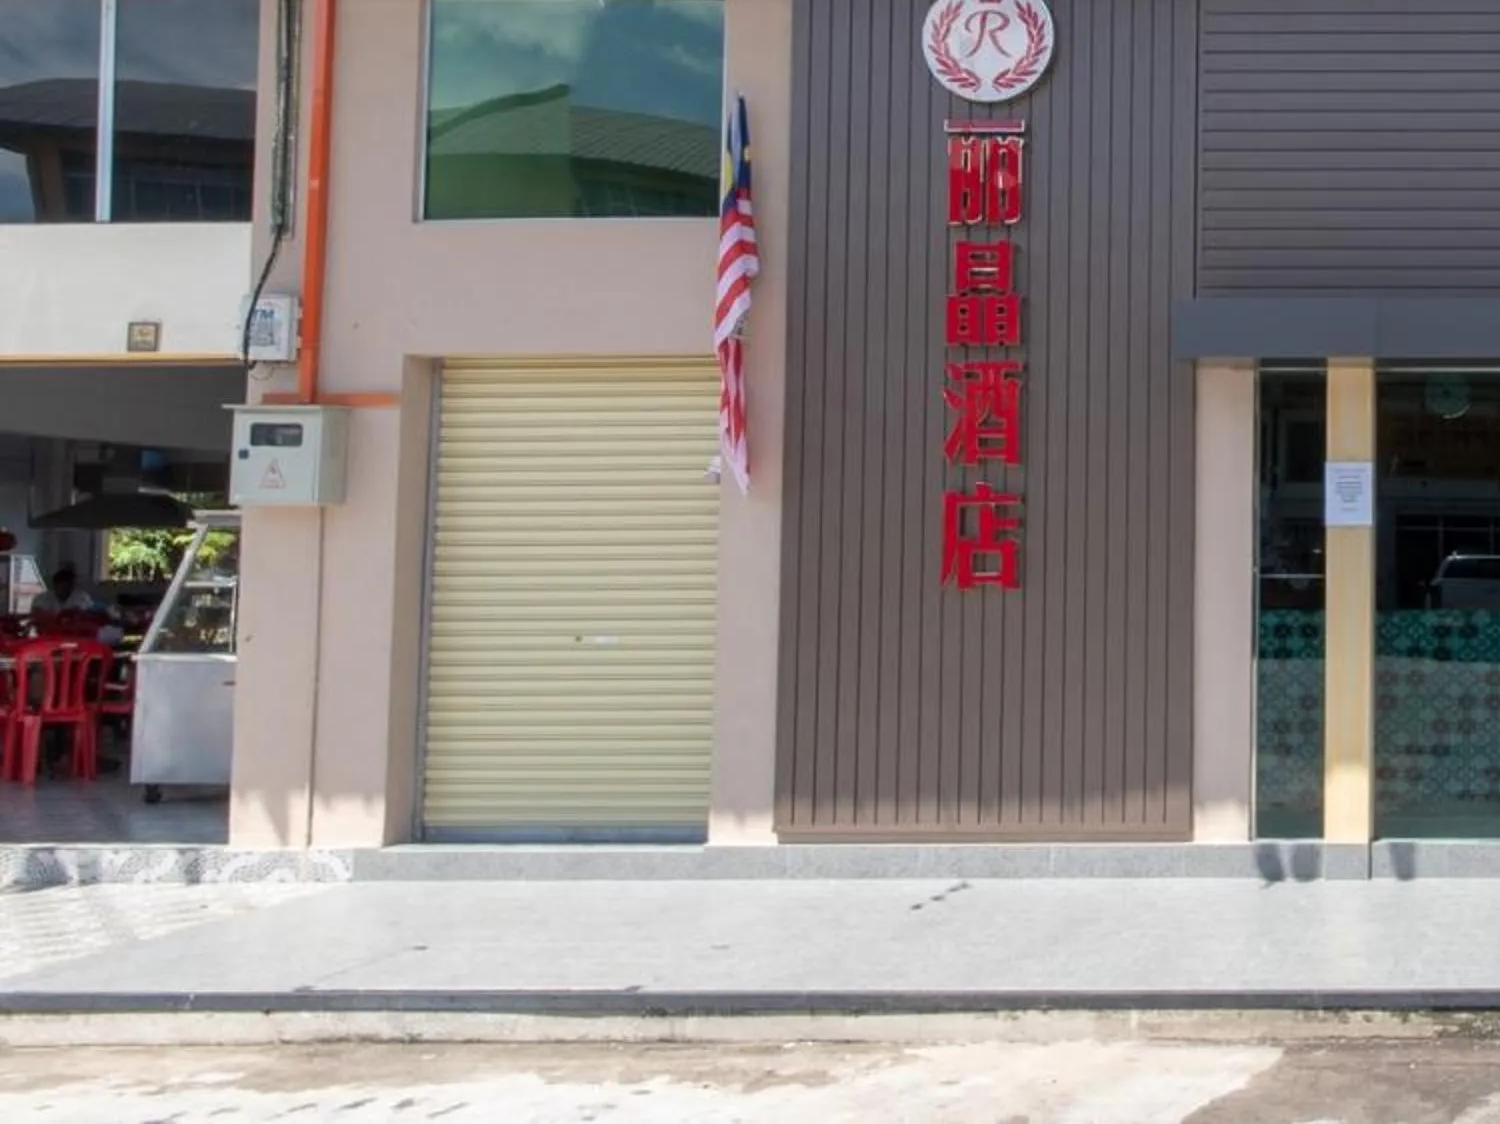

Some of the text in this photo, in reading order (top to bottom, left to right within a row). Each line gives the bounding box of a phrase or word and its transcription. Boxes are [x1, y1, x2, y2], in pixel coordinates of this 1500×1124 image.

[964, 10, 1011, 59] R
[941, 119, 1025, 590] 丽晶酒店
